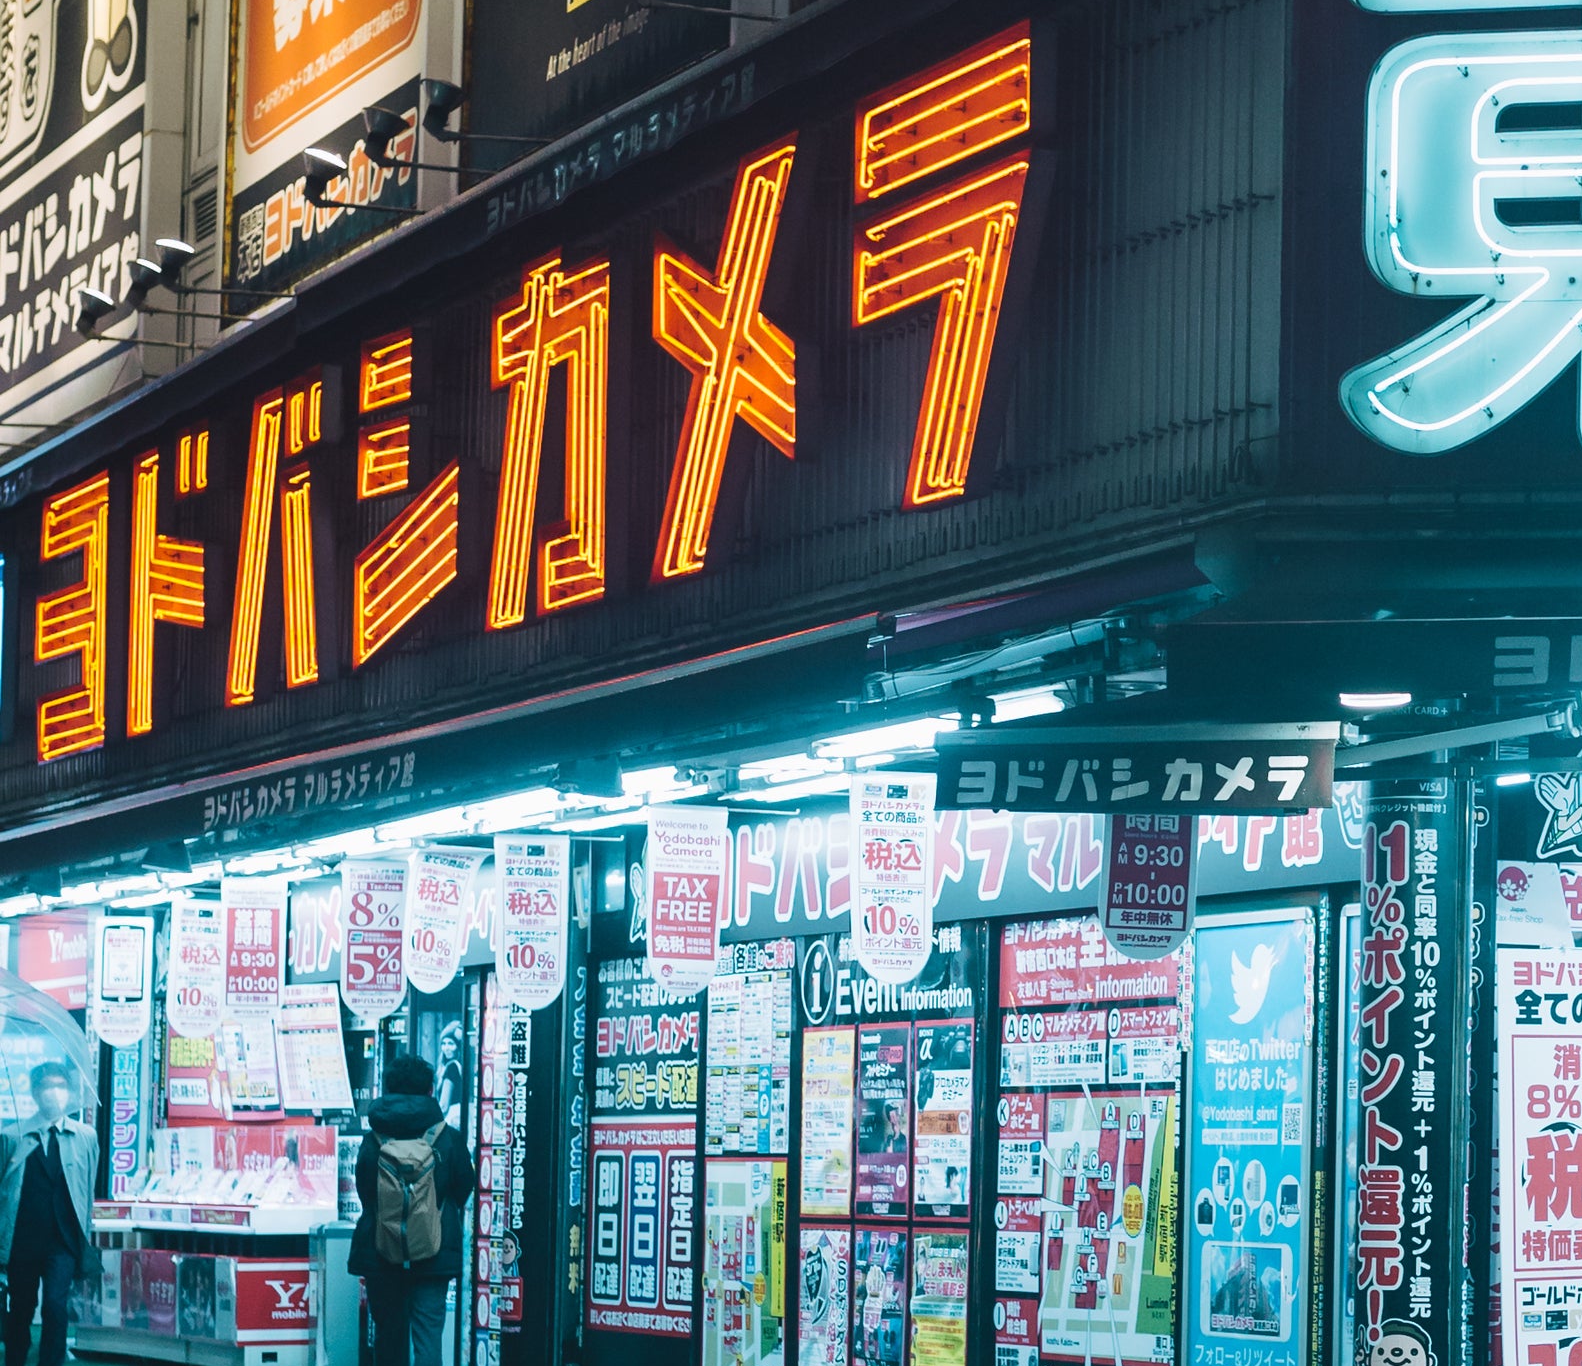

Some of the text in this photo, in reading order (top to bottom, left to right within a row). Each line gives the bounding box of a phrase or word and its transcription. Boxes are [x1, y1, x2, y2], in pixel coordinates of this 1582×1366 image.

[546, 36, 596, 82] At the heart
[487, 142, 601, 233] ヨドバシカメラ
[34, 19, 1031, 763] ヨドバシカメラ
[204, 750, 416, 831] ヨドバシカメラ マルチメディア館
[956, 754, 1310, 805] ヨドバシカメラ
[1419, 782, 1443, 793] VISA
[655, 819, 709, 831] Welcome to
[861, 810, 926, 824] 全ての商品が
[654, 831, 721, 847] Yodobashi
[662, 844, 713, 859] Camera
[864, 841, 922, 872] 税込
[1134, 844, 1185, 869] 9:30
[505, 866, 560, 878] 全ての商品が
[417, 878, 461, 906] 税込
[663, 876, 708, 900] TAX
[1123, 882, 1187, 907] 10:00
[349, 891, 400, 928] 8%
[508, 891, 558, 917] 税込
[656, 899, 713, 924] FREE
[865, 905, 920, 937] 10%
[1120, 910, 1174, 926] 年中無休
[1524, 914, 1544, 924] Shop
[414, 928, 451, 957] 10%
[654, 934, 686, 955] 免税
[864, 937, 922, 950] ポイント還元
[1116, 932, 1172, 943] ヨドバシカメラ
[181, 946, 221, 966] 税込
[240, 951, 276, 969] 9:30
[348, 944, 401, 985] 5%
[508, 944, 556, 970] 10%
[1015, 945, 1077, 974] 新宿西口本店
[235, 976, 278, 993] 10:00
[507, 970, 558, 981] ポイント還元
[1094, 971, 1168, 1000] information
[179, 987, 218, 1008] 10%
[835, 968, 974, 1016] Event Information
[1045, 1011, 1107, 1034] マルチメディア館
[1121, 1008, 1178, 1028] スマートフォン館
[1204, 1037, 1302, 1065] 西口店のTwitter
[935, 1076, 970, 1088] プロカメラマン
[1214, 1065, 1289, 1092] はじめました
[1010, 1096, 1033, 1112] ゲーム
[1201, 1105, 1279, 1125] @Yodobashi_sinni
[1010, 1112, 1040, 1131] ホビー館
[598, 1160, 620, 1257] 即日
[632, 1161, 656, 1259] 翌日
[670, 1159, 694, 1263] 指定日
[1007, 1199, 1042, 1218] トラベル館
[594, 1262, 619, 1297] 配達
[629, 1263, 656, 1301] 配達
[666, 1266, 693, 1303] 配達
[271, 1308, 309, 1321] mobile
[1211, 1313, 1255, 1331] ヨドバシカメラ
